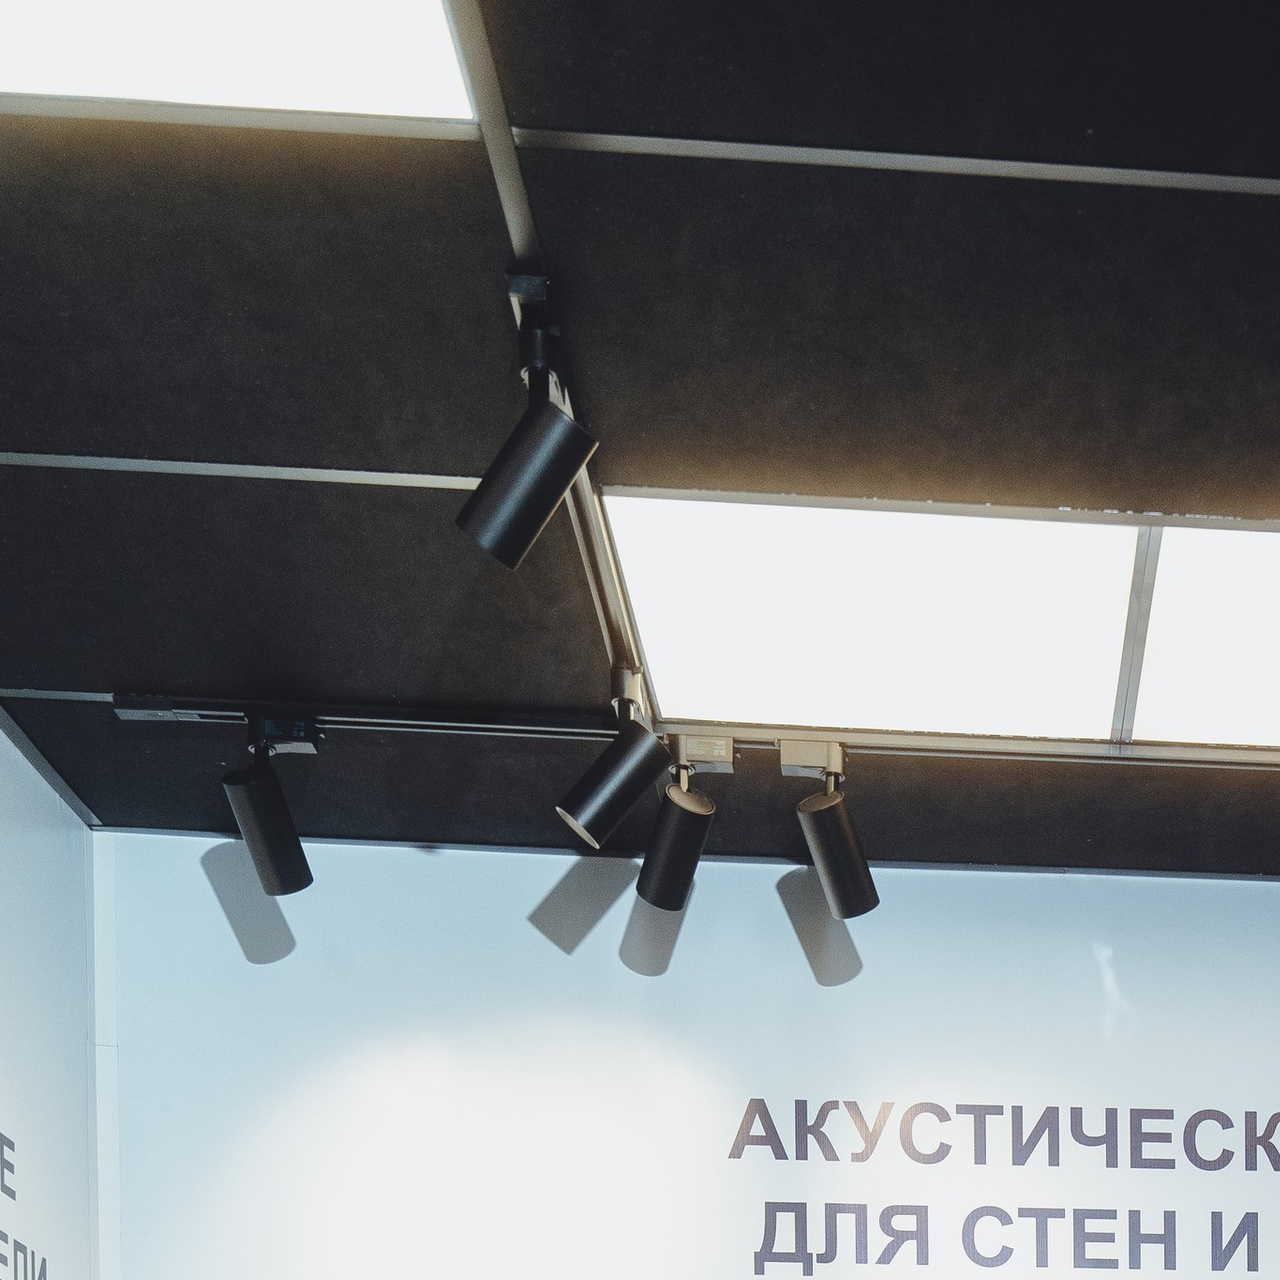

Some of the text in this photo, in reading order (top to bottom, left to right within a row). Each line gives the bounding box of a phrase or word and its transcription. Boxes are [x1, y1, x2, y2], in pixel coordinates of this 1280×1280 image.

[754, 1202, 929, 1277] ДЛЯ
[961, 1206, 1177, 1271] СТЕН
[1210, 1211, 1259, 1273] И
